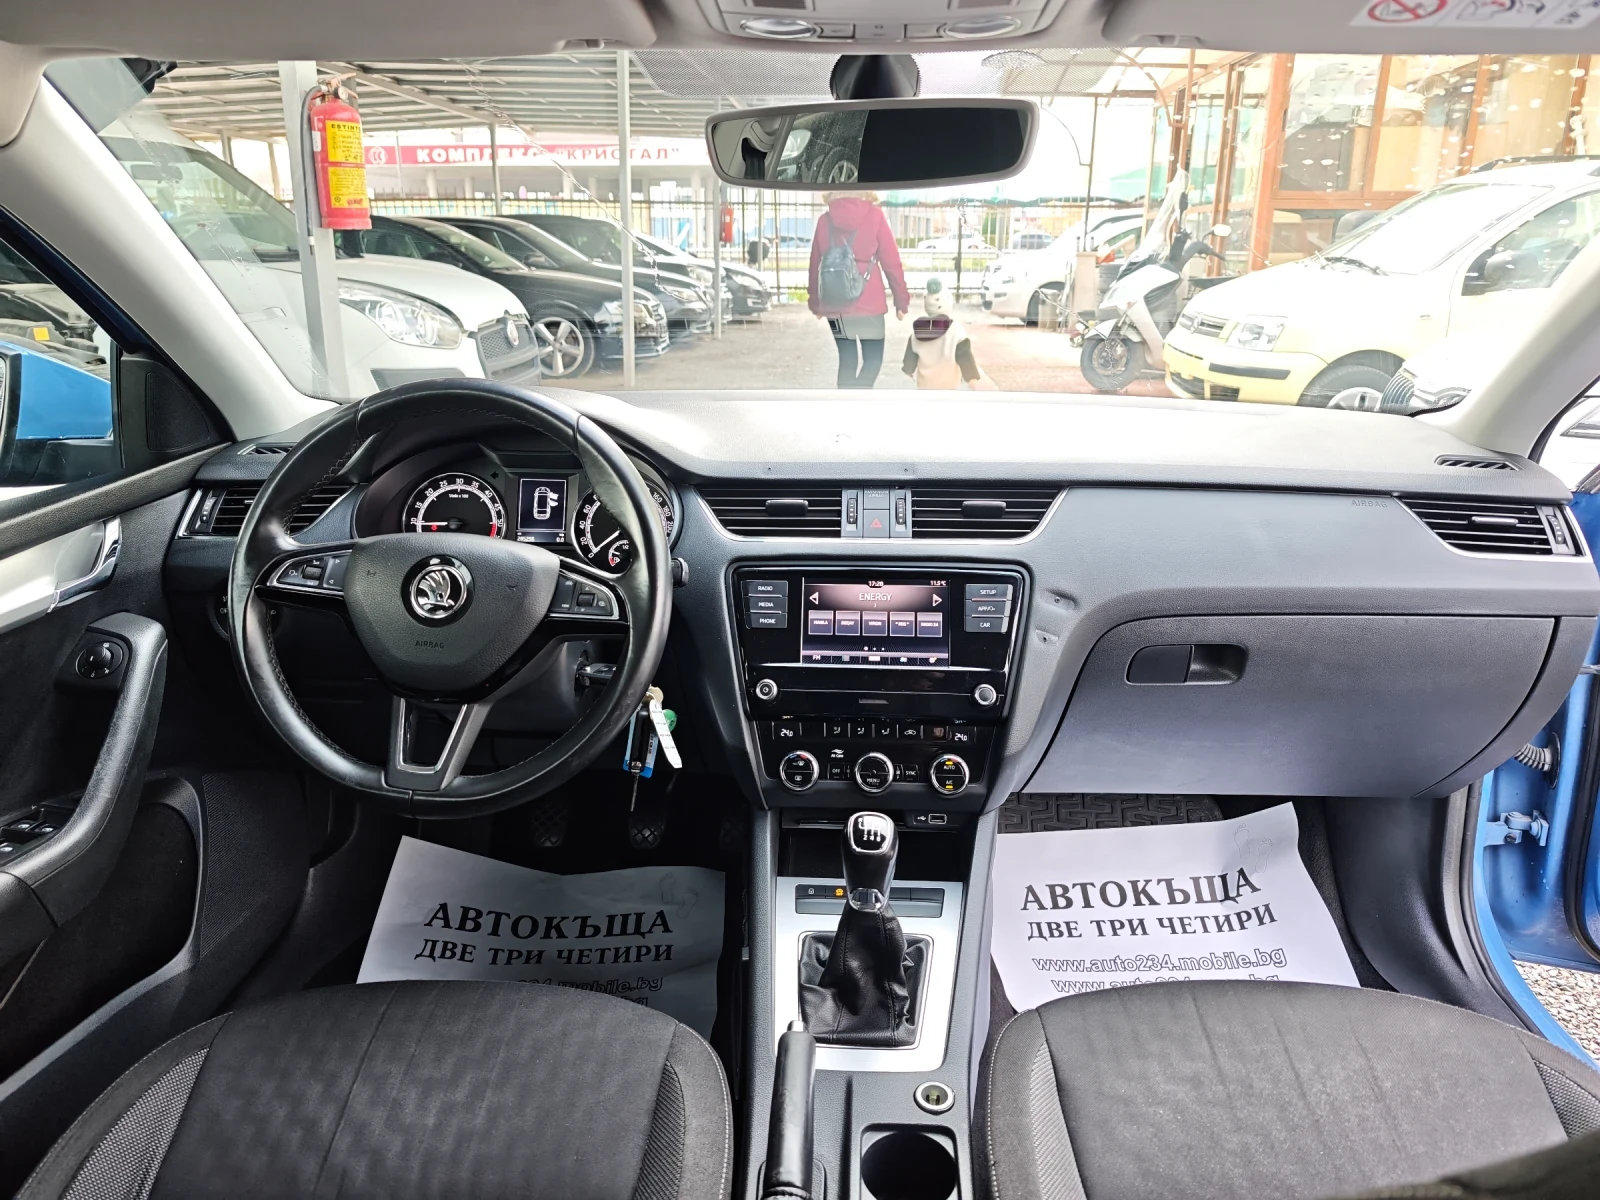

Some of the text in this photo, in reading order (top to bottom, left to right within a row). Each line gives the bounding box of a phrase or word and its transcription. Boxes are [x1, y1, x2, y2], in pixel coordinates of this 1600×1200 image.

[439, 480, 448, 488] 25
[471, 480, 480, 488] 35
[424, 488, 434, 497] 20
[484, 489, 493, 498] 40
[652, 491, 663, 503] 160
[1351, 499, 1388, 508] AIRBAG
[579, 520, 586, 529] 40
[580, 537, 588, 545] 20
[859, 592, 892, 601] ENERGY
[415, 640, 445, 649] AIRBAG
[1020, 867, 1262, 911] АВТОКЪЩА
[423, 902, 673, 940] АВТОКЪЩА
[1027, 903, 1278, 941] ДВЕ ТРИ ЧЕТИРИ
[414, 938, 675, 966] ДВЕ ТРИ ЧЕТИРИ
[1031, 947, 1288, 972] www.auto234.mobile.bg
